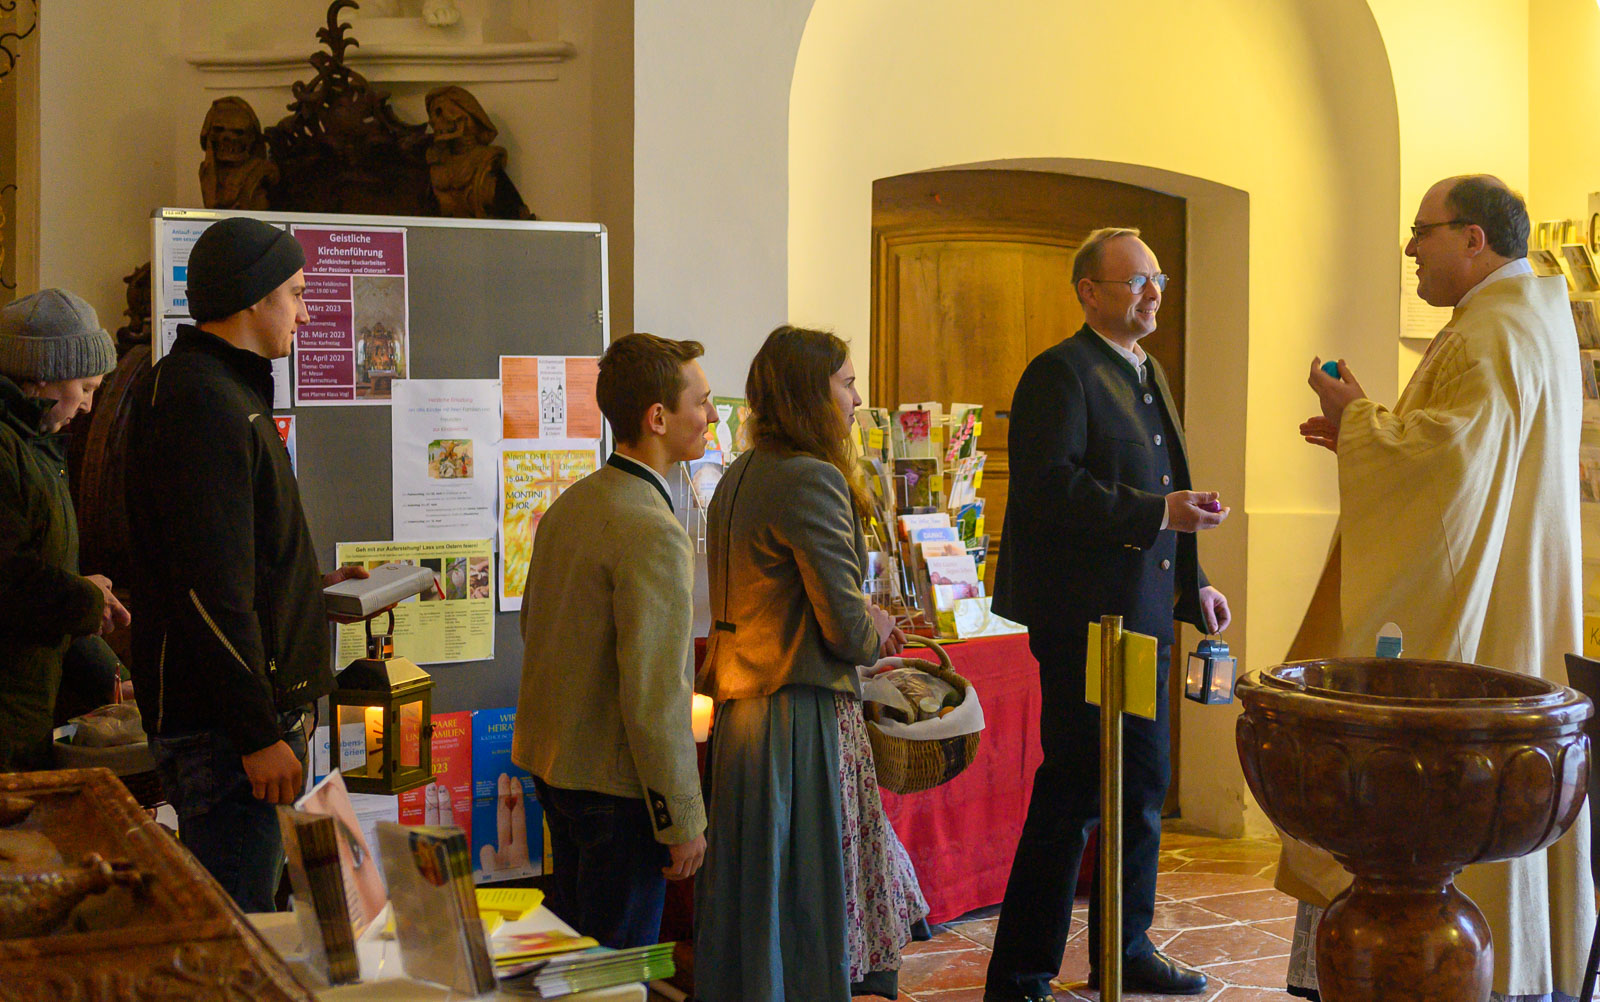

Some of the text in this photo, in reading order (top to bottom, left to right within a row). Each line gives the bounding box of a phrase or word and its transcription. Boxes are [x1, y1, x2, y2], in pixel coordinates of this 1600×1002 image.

[330, 233, 371, 243] Geistliche
[318, 246, 383, 259] Kirchenführung
[500, 713, 516, 722] WIR
[432, 728, 465, 738] AMILIEN
[488, 723, 514, 734] HEIRA
[432, 762, 448, 775] 023
